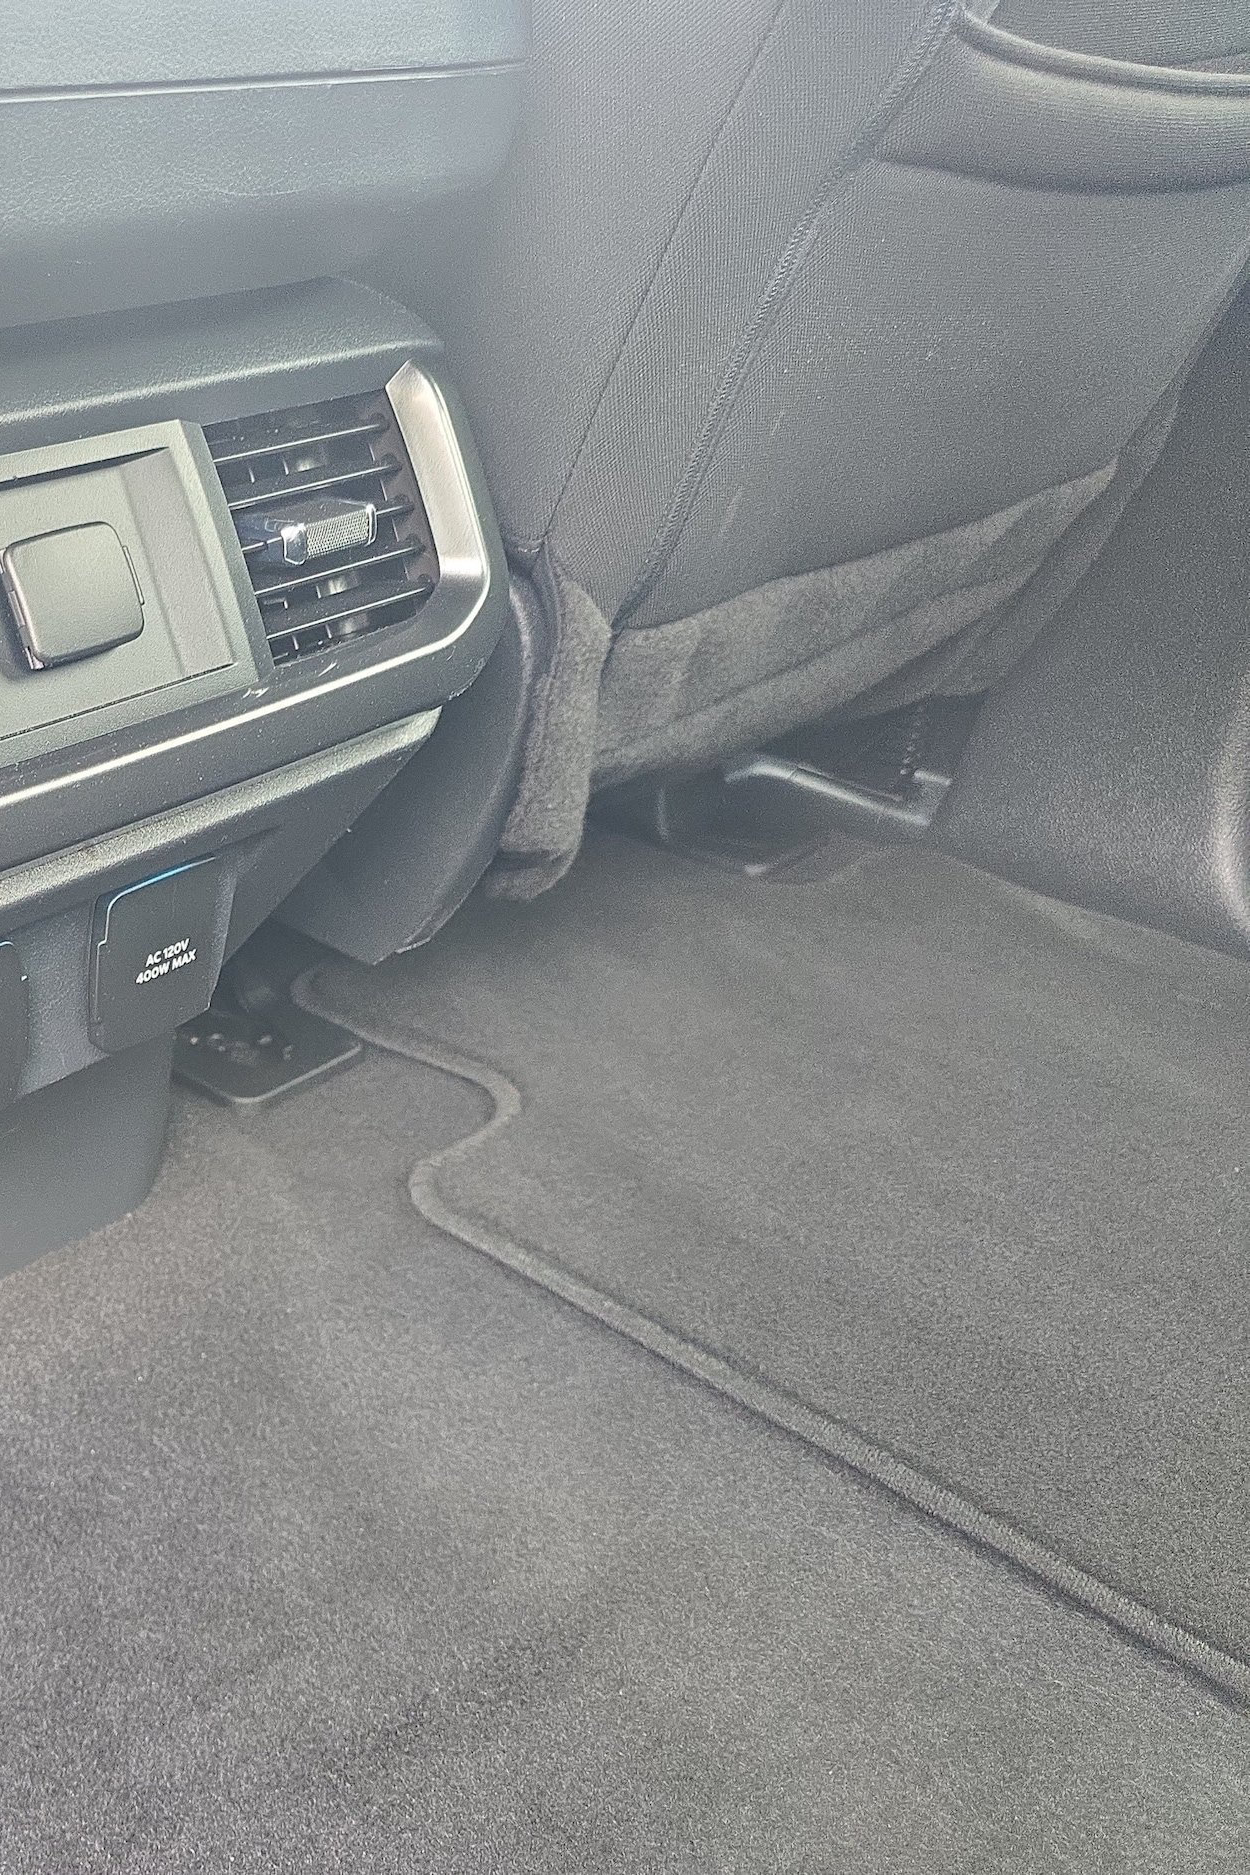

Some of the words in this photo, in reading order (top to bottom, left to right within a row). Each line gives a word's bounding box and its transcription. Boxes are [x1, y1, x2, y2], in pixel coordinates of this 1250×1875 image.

[135, 961, 170, 984] 400W
[171, 948, 197, 970] MAX
[145, 950, 162, 967] AC
[162, 938, 190, 959] 120V
